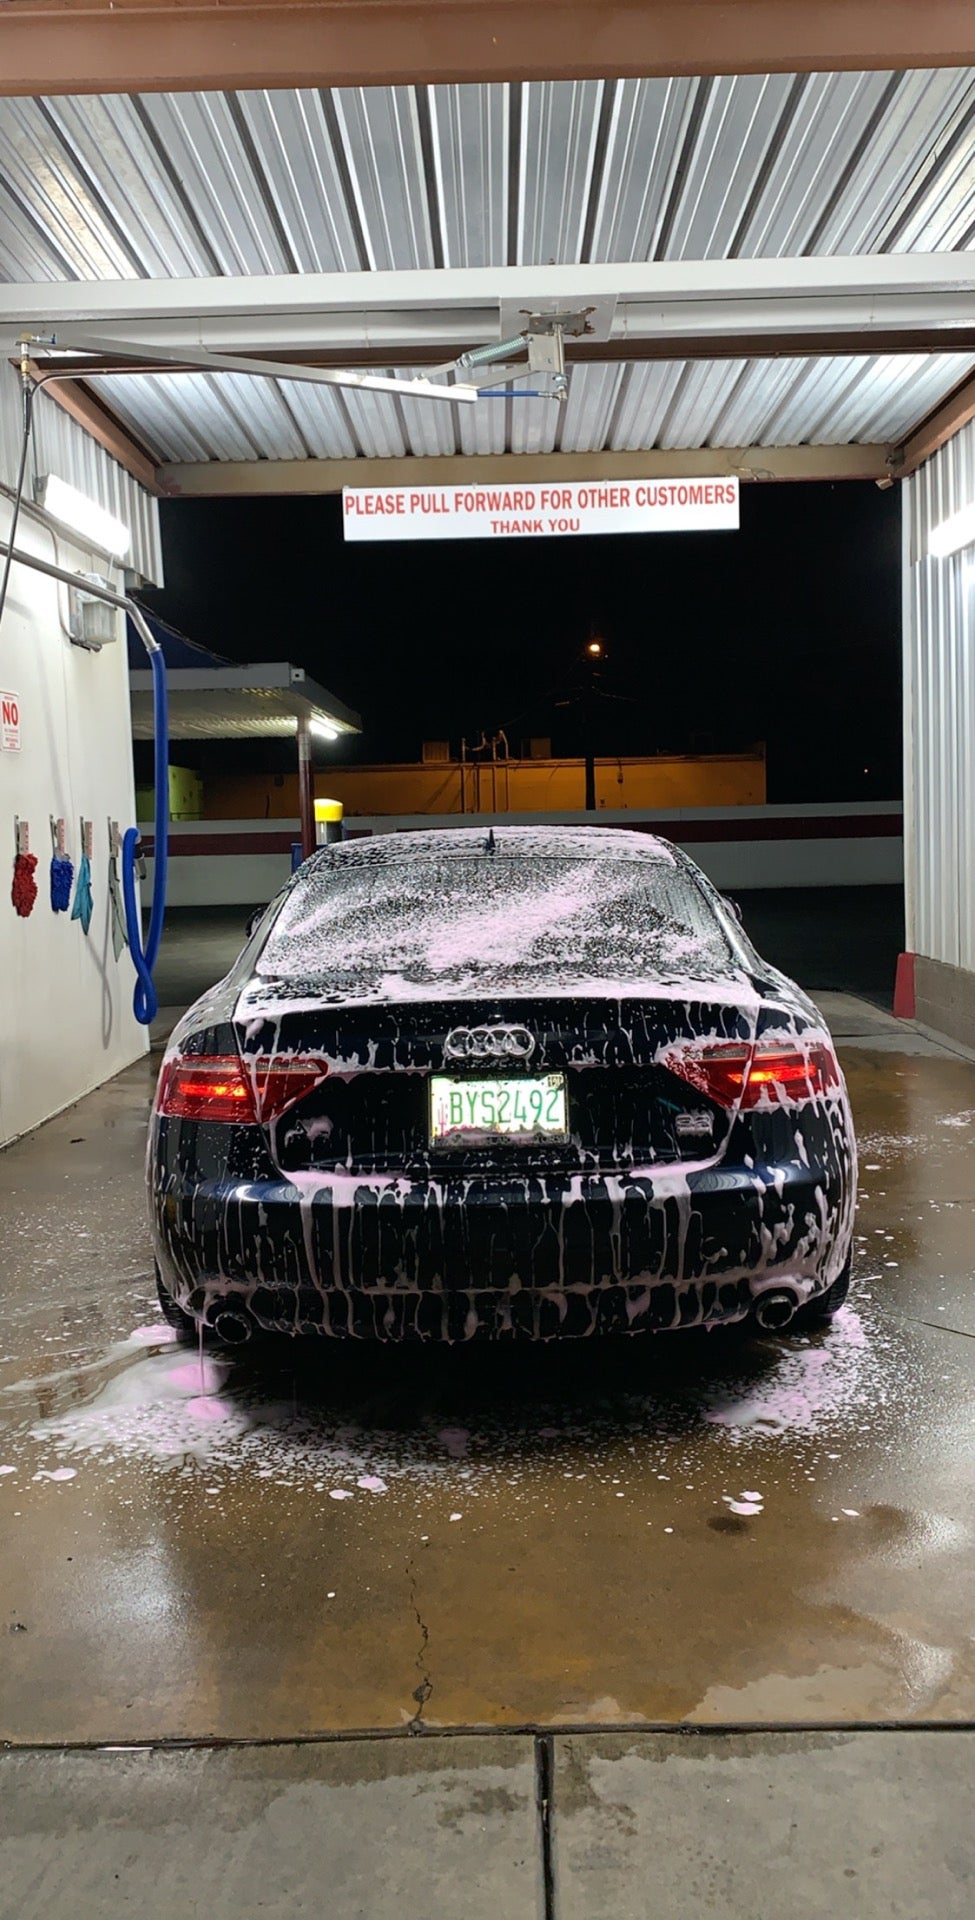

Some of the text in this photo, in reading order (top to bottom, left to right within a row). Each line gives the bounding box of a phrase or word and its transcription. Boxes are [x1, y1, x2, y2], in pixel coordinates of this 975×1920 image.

[345, 484, 736, 515] PLEASE PULL FORWARD FOR OTHER CUSTOMERS
[490, 518, 580, 534] THANK YOU
[2, 700, 18, 726] NO
[449, 1089, 560, 1125] BYS2492
